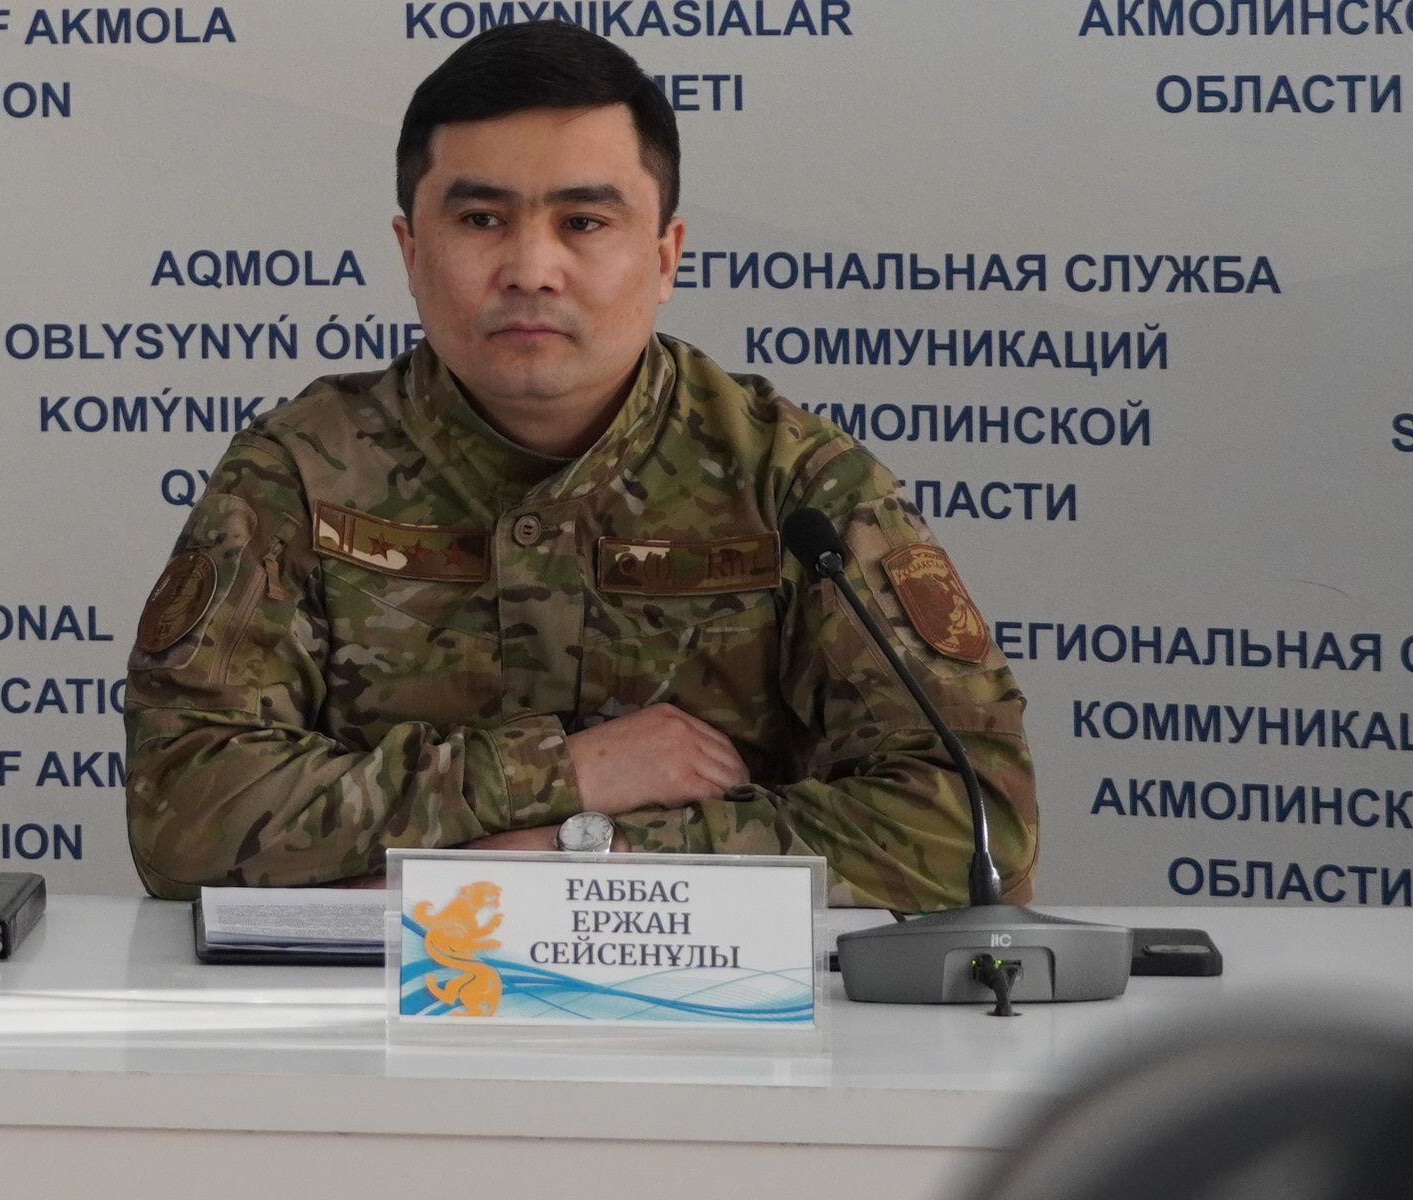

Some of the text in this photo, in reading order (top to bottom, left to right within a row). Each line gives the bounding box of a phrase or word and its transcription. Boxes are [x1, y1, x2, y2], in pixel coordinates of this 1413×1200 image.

[24, 6, 237, 46] AKMOLA
[1154, 73, 1403, 115] ОБЛАСТИ
[150, 248, 367, 288] AQMOLA
[671, 250, 1281, 295] ЕГИОНАЛЬНАЯ СЛУЖБА
[4, 310, 299, 361] OBLYSYNYŃ
[745, 321, 1169, 377] КОММУНИКАЦИЙ
[905, 478, 1078, 521] ЛАСТИ
[993, 620, 1383, 672] ЕГИОНАЛЬНАЯ
[565, 878, 691, 904] ҒАББАС
[1167, 856, 1413, 907] ОБЛАСТИ
[570, 909, 693, 936] ЕРЖАН
[529, 934, 742, 969] СЕЙСЕНҰЛЫ
